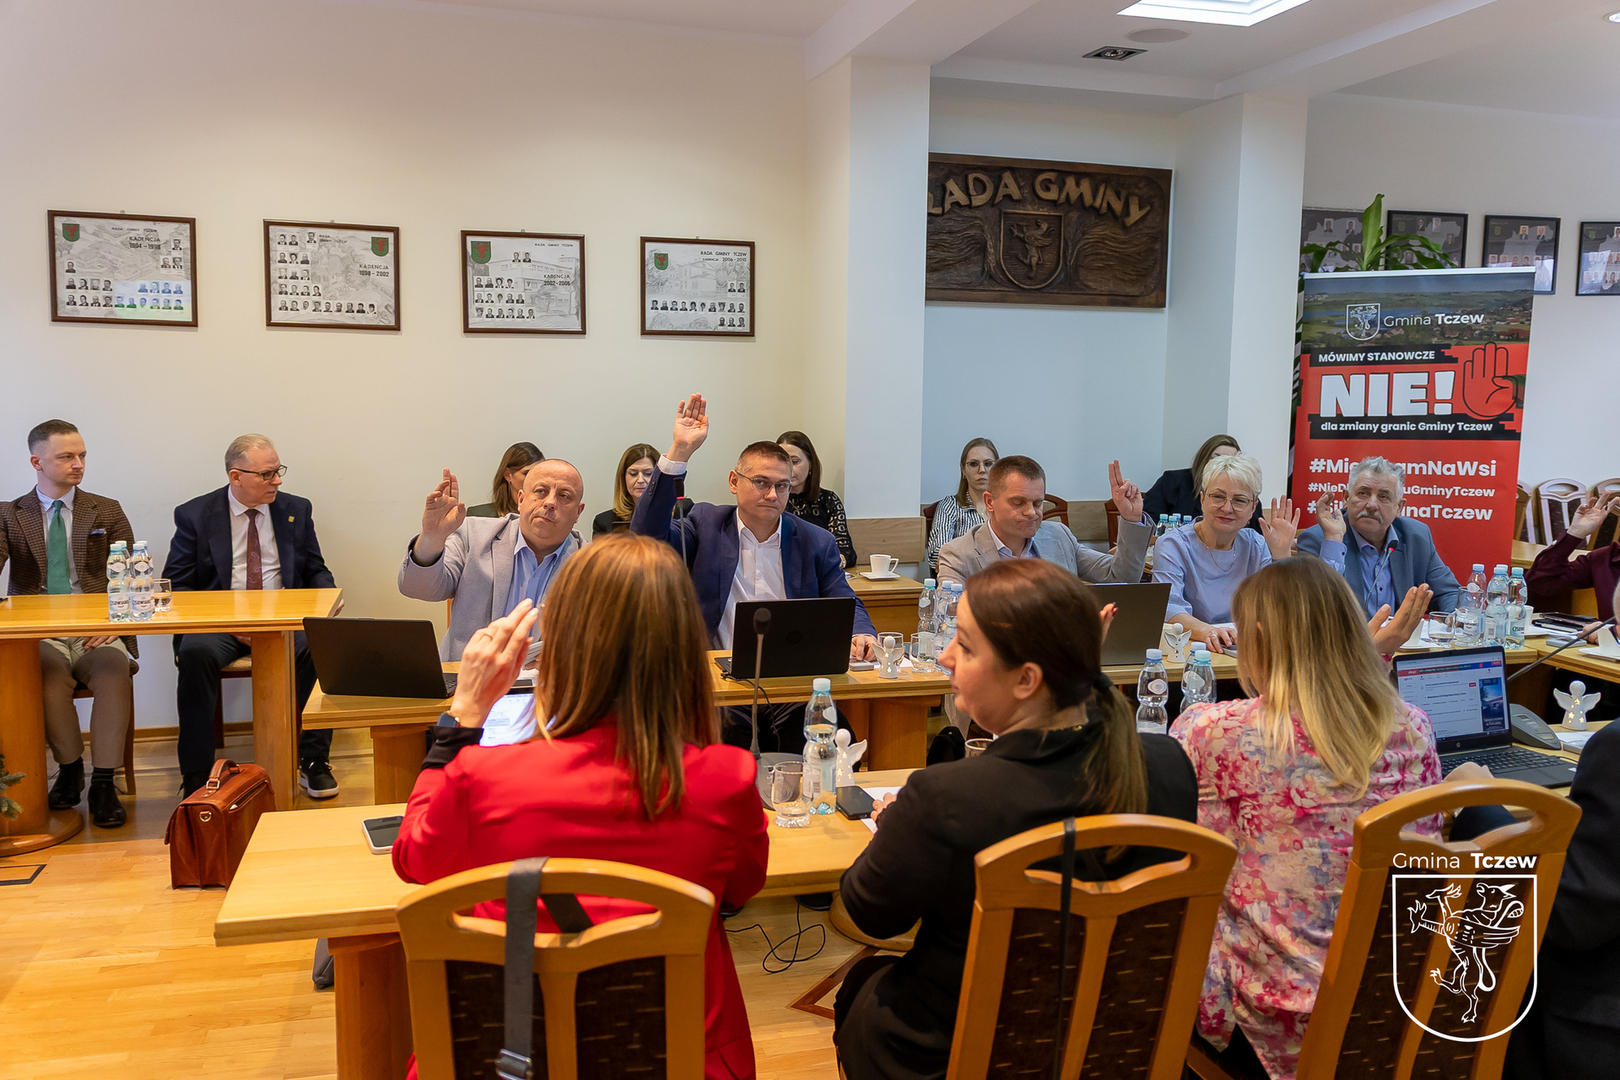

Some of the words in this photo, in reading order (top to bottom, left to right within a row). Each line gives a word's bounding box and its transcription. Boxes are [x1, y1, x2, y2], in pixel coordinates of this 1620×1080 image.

[1034, 171, 1150, 227] GMINY
[1383, 314, 1432, 327] Gmina
[1434, 313, 1485, 326] Tczew
[1318, 351, 1365, 363] MÓWIMY
[1367, 350, 1435, 361] STANOWCZE
[1319, 370, 1456, 418] NIE!
[1320, 422, 1338, 431] dla
[1339, 422, 1379, 433] zmiany
[1380, 422, 1417, 433] granic
[1418, 422, 1457, 433] Gminy
[1458, 422, 1493, 431] Tczew
[1309, 457, 1496, 477] #MimNaWsi
